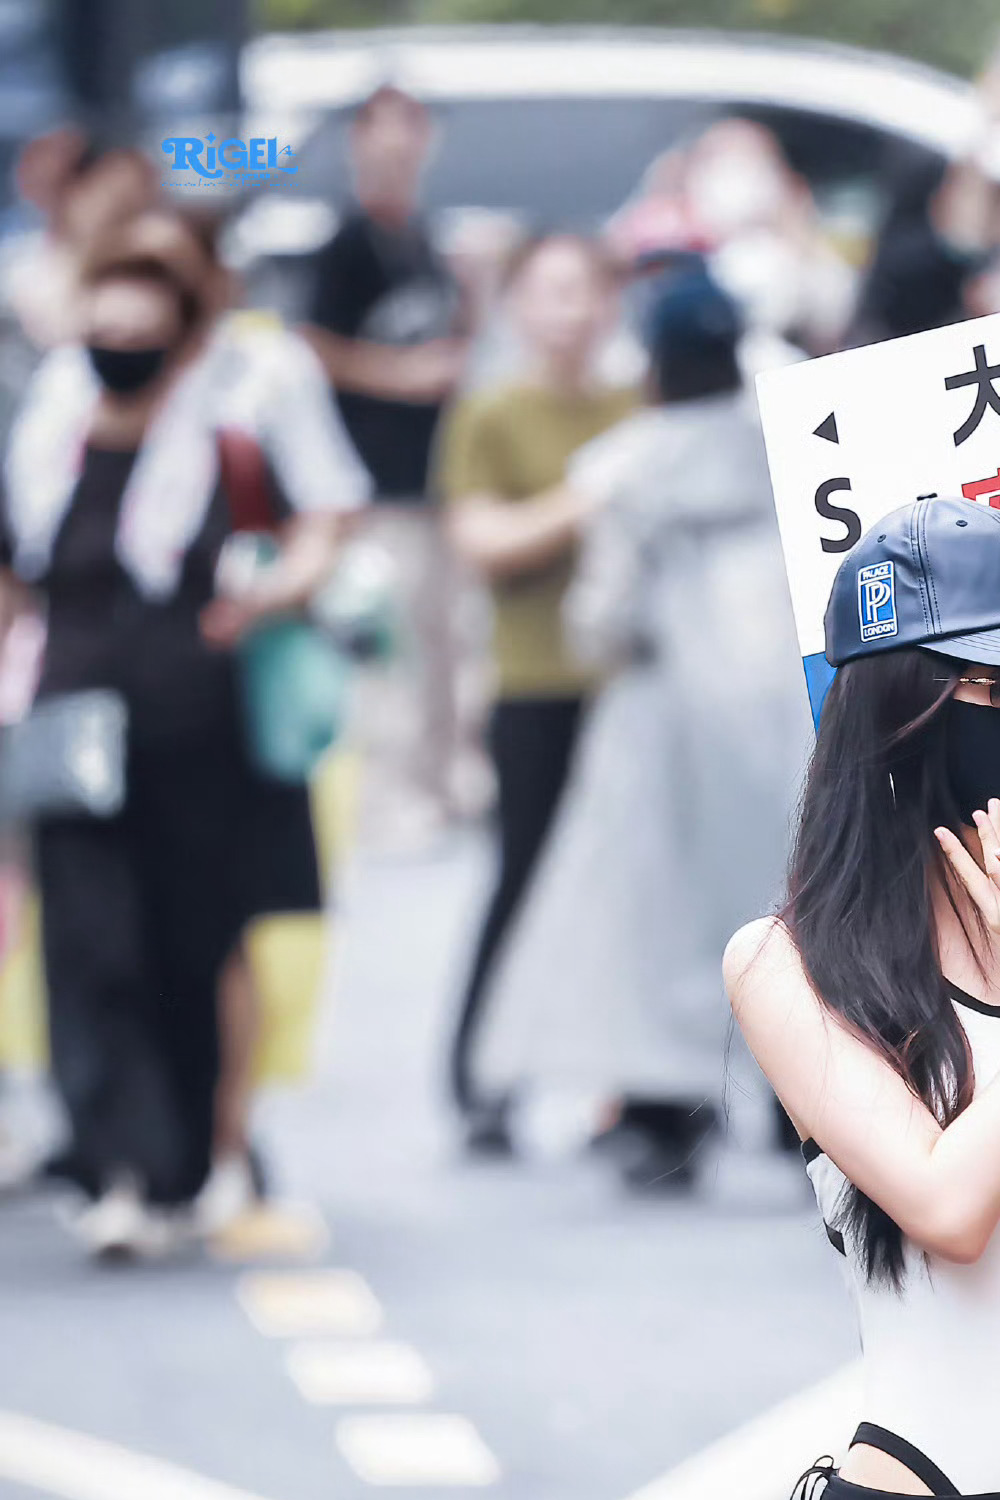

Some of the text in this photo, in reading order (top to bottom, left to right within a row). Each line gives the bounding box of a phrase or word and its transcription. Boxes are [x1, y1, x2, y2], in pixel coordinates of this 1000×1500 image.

[814, 477, 862, 554] S
[862, 565, 889, 581] PALACE
[864, 623, 895, 637] LONDON
